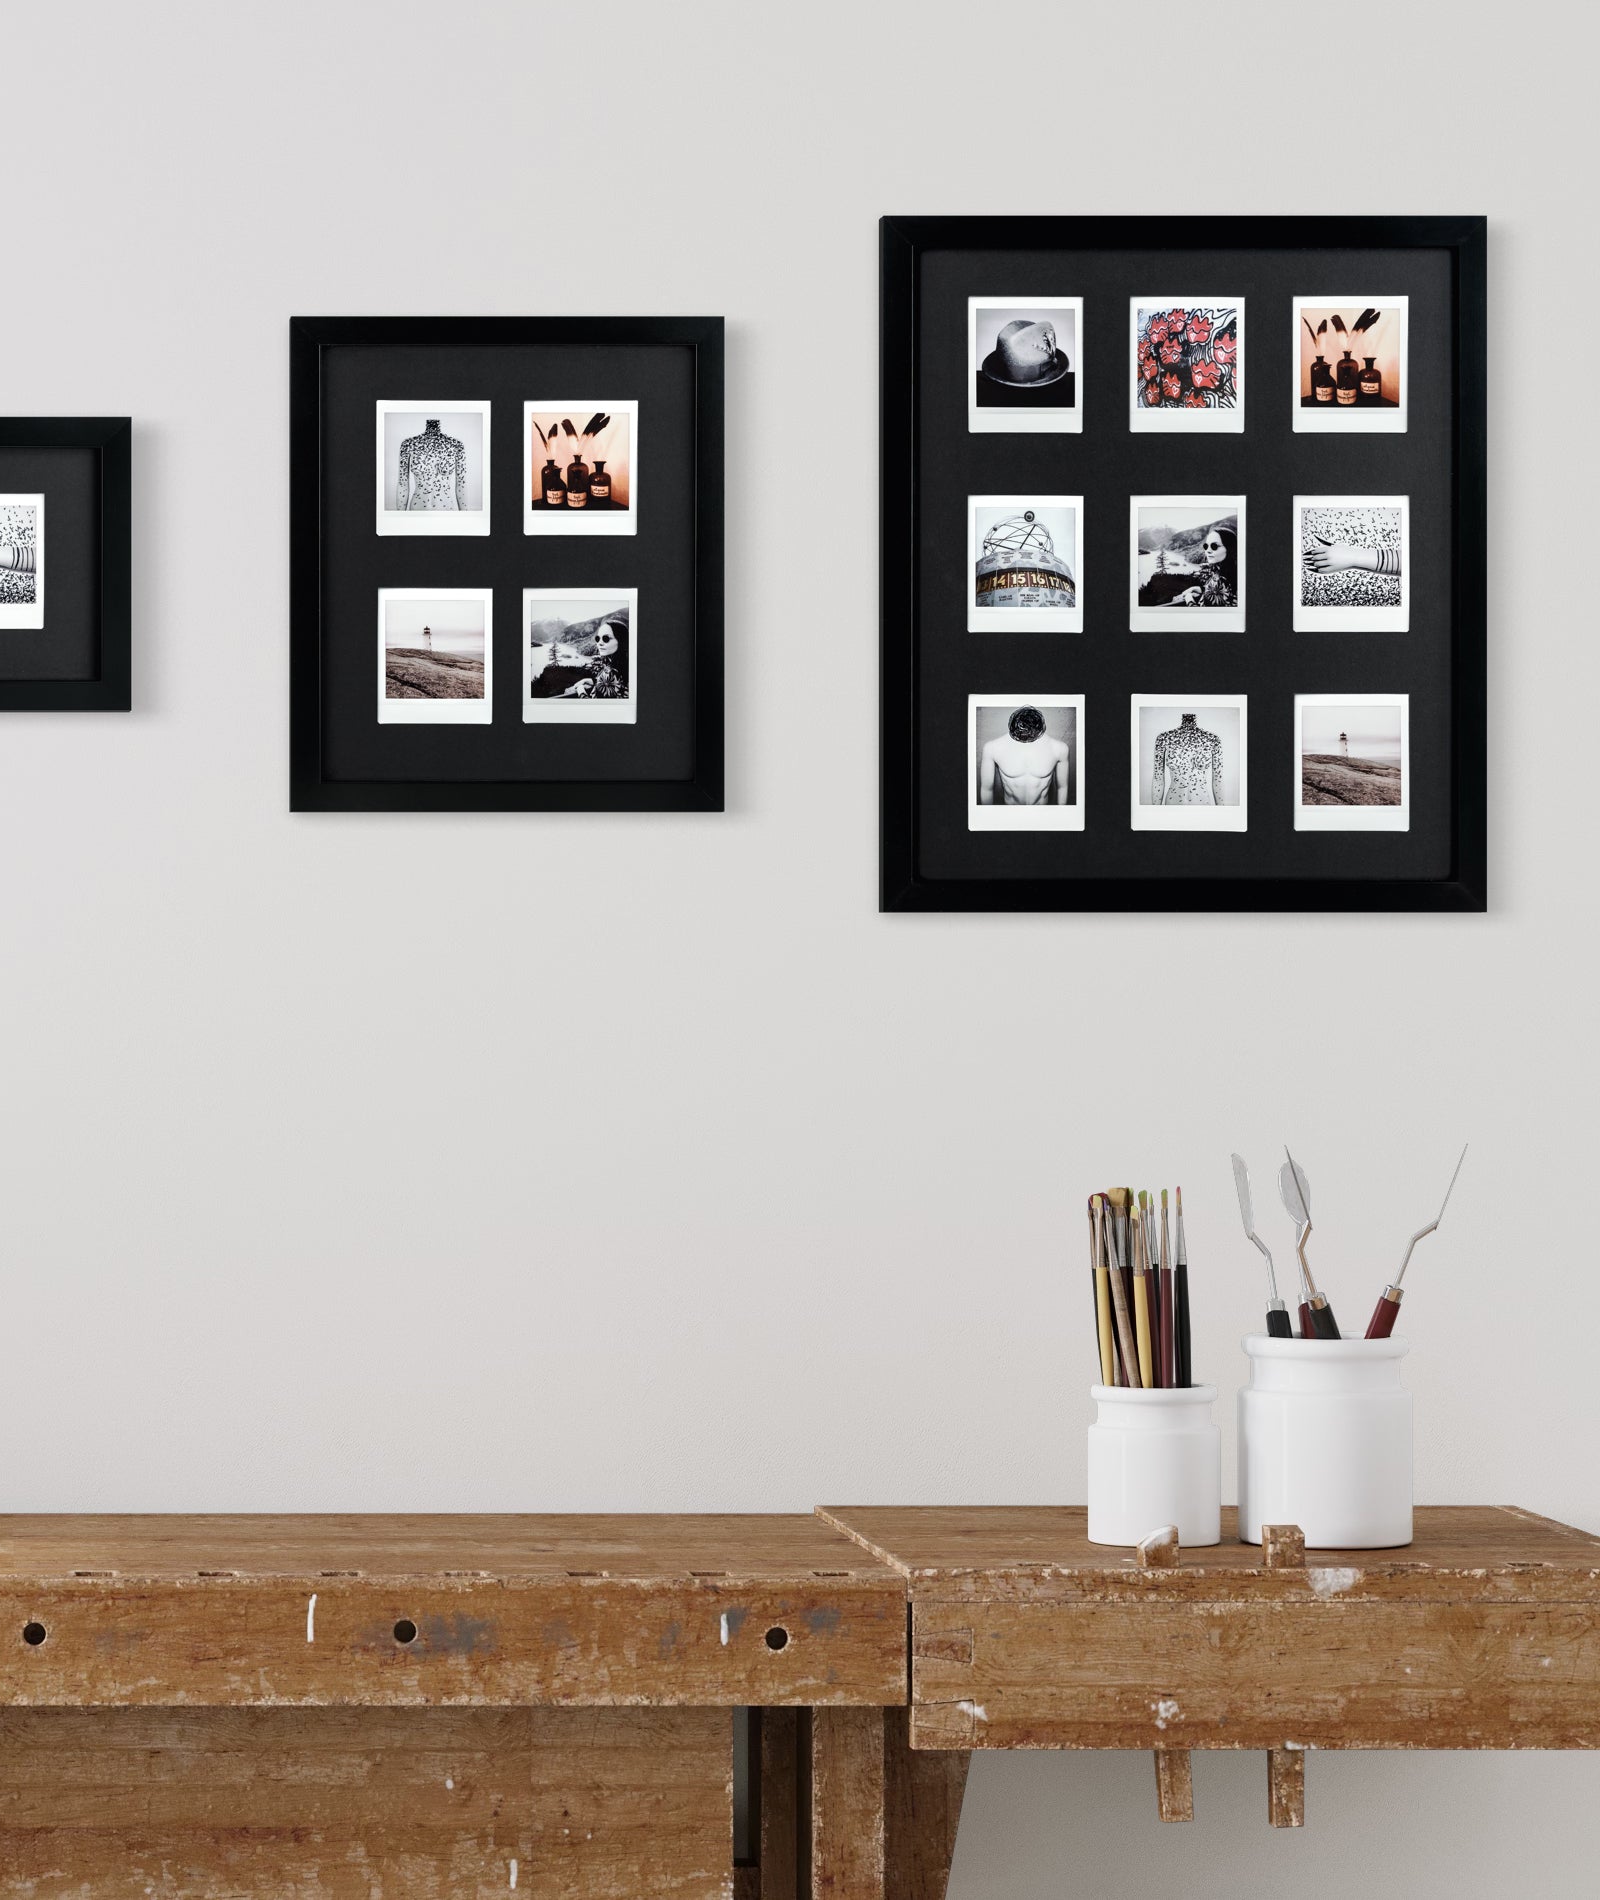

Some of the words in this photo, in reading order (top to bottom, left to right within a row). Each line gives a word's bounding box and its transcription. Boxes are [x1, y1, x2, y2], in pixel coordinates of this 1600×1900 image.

[992, 575, 1006, 587] 14
[1011, 573, 1026, 585] 15
[1031, 573, 1046, 585] 16
[1048, 575, 1059, 587] 17
